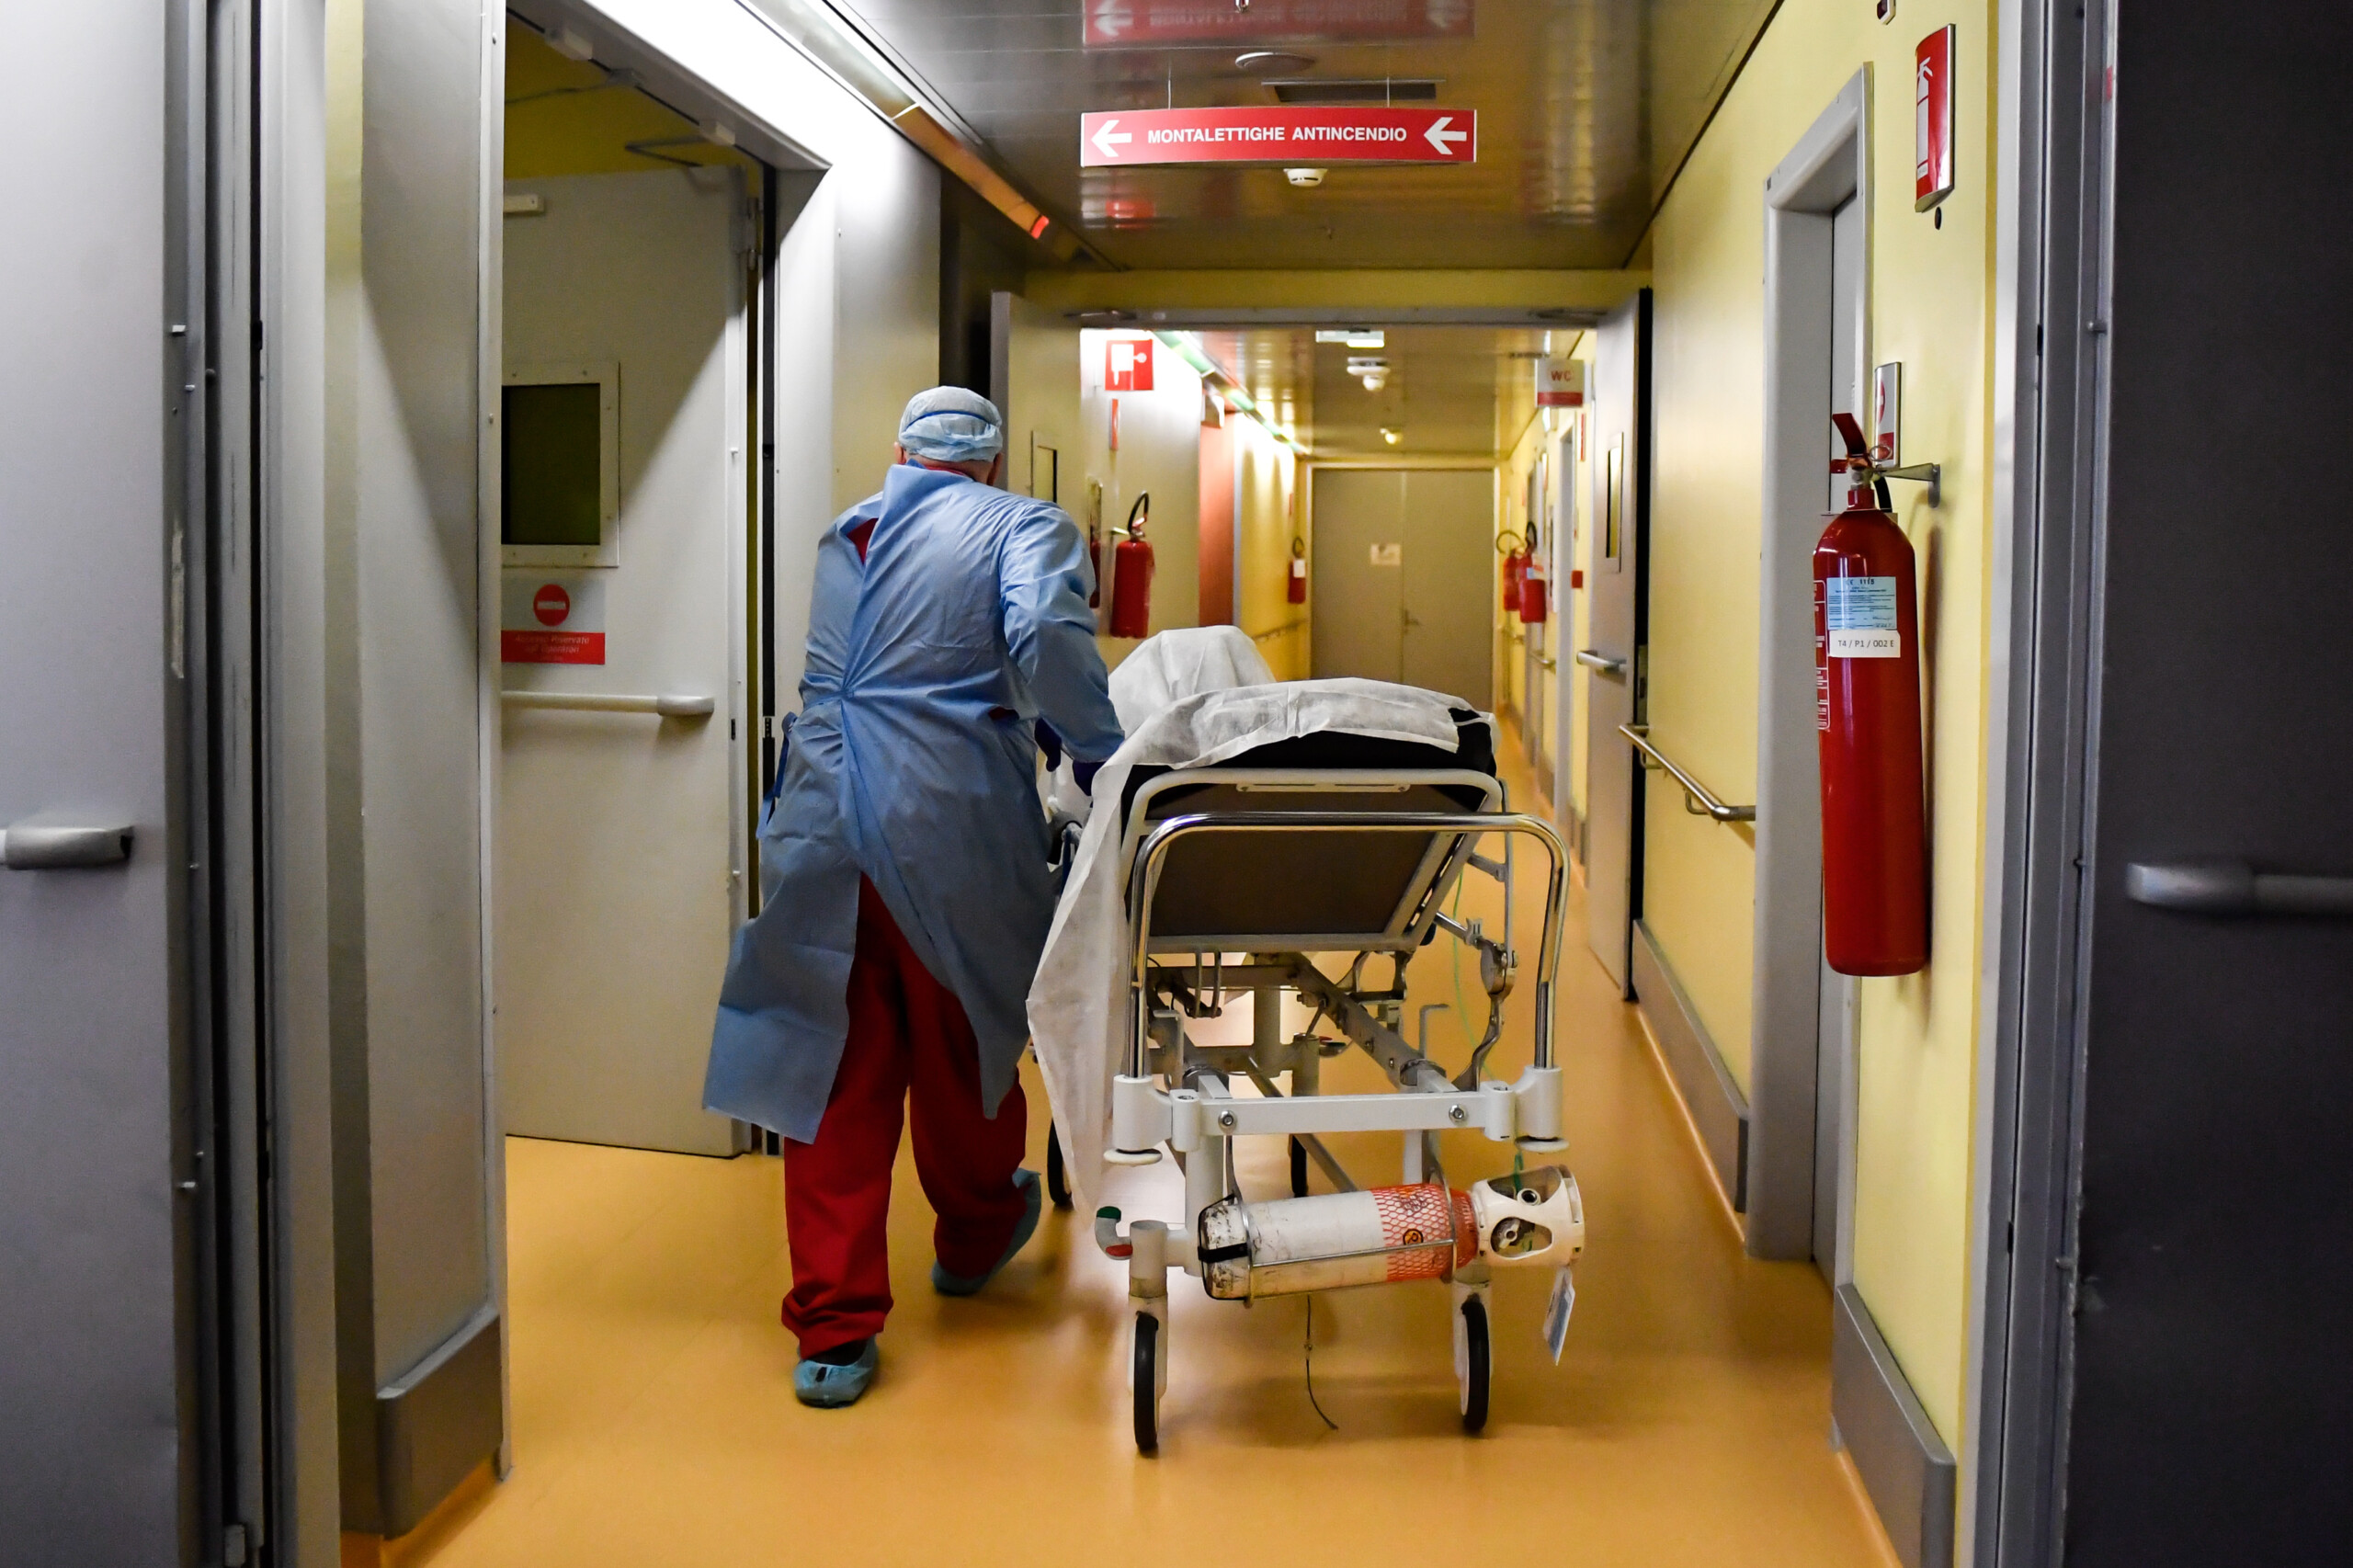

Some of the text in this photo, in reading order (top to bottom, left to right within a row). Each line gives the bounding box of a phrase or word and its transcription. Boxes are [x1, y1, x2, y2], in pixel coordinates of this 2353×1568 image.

[1148, 126, 1407, 143] MONTALETTIGHE ANTINCENDIO
[1551, 370, 1571, 381] WC
[1872, 640, 1888, 648] 002
